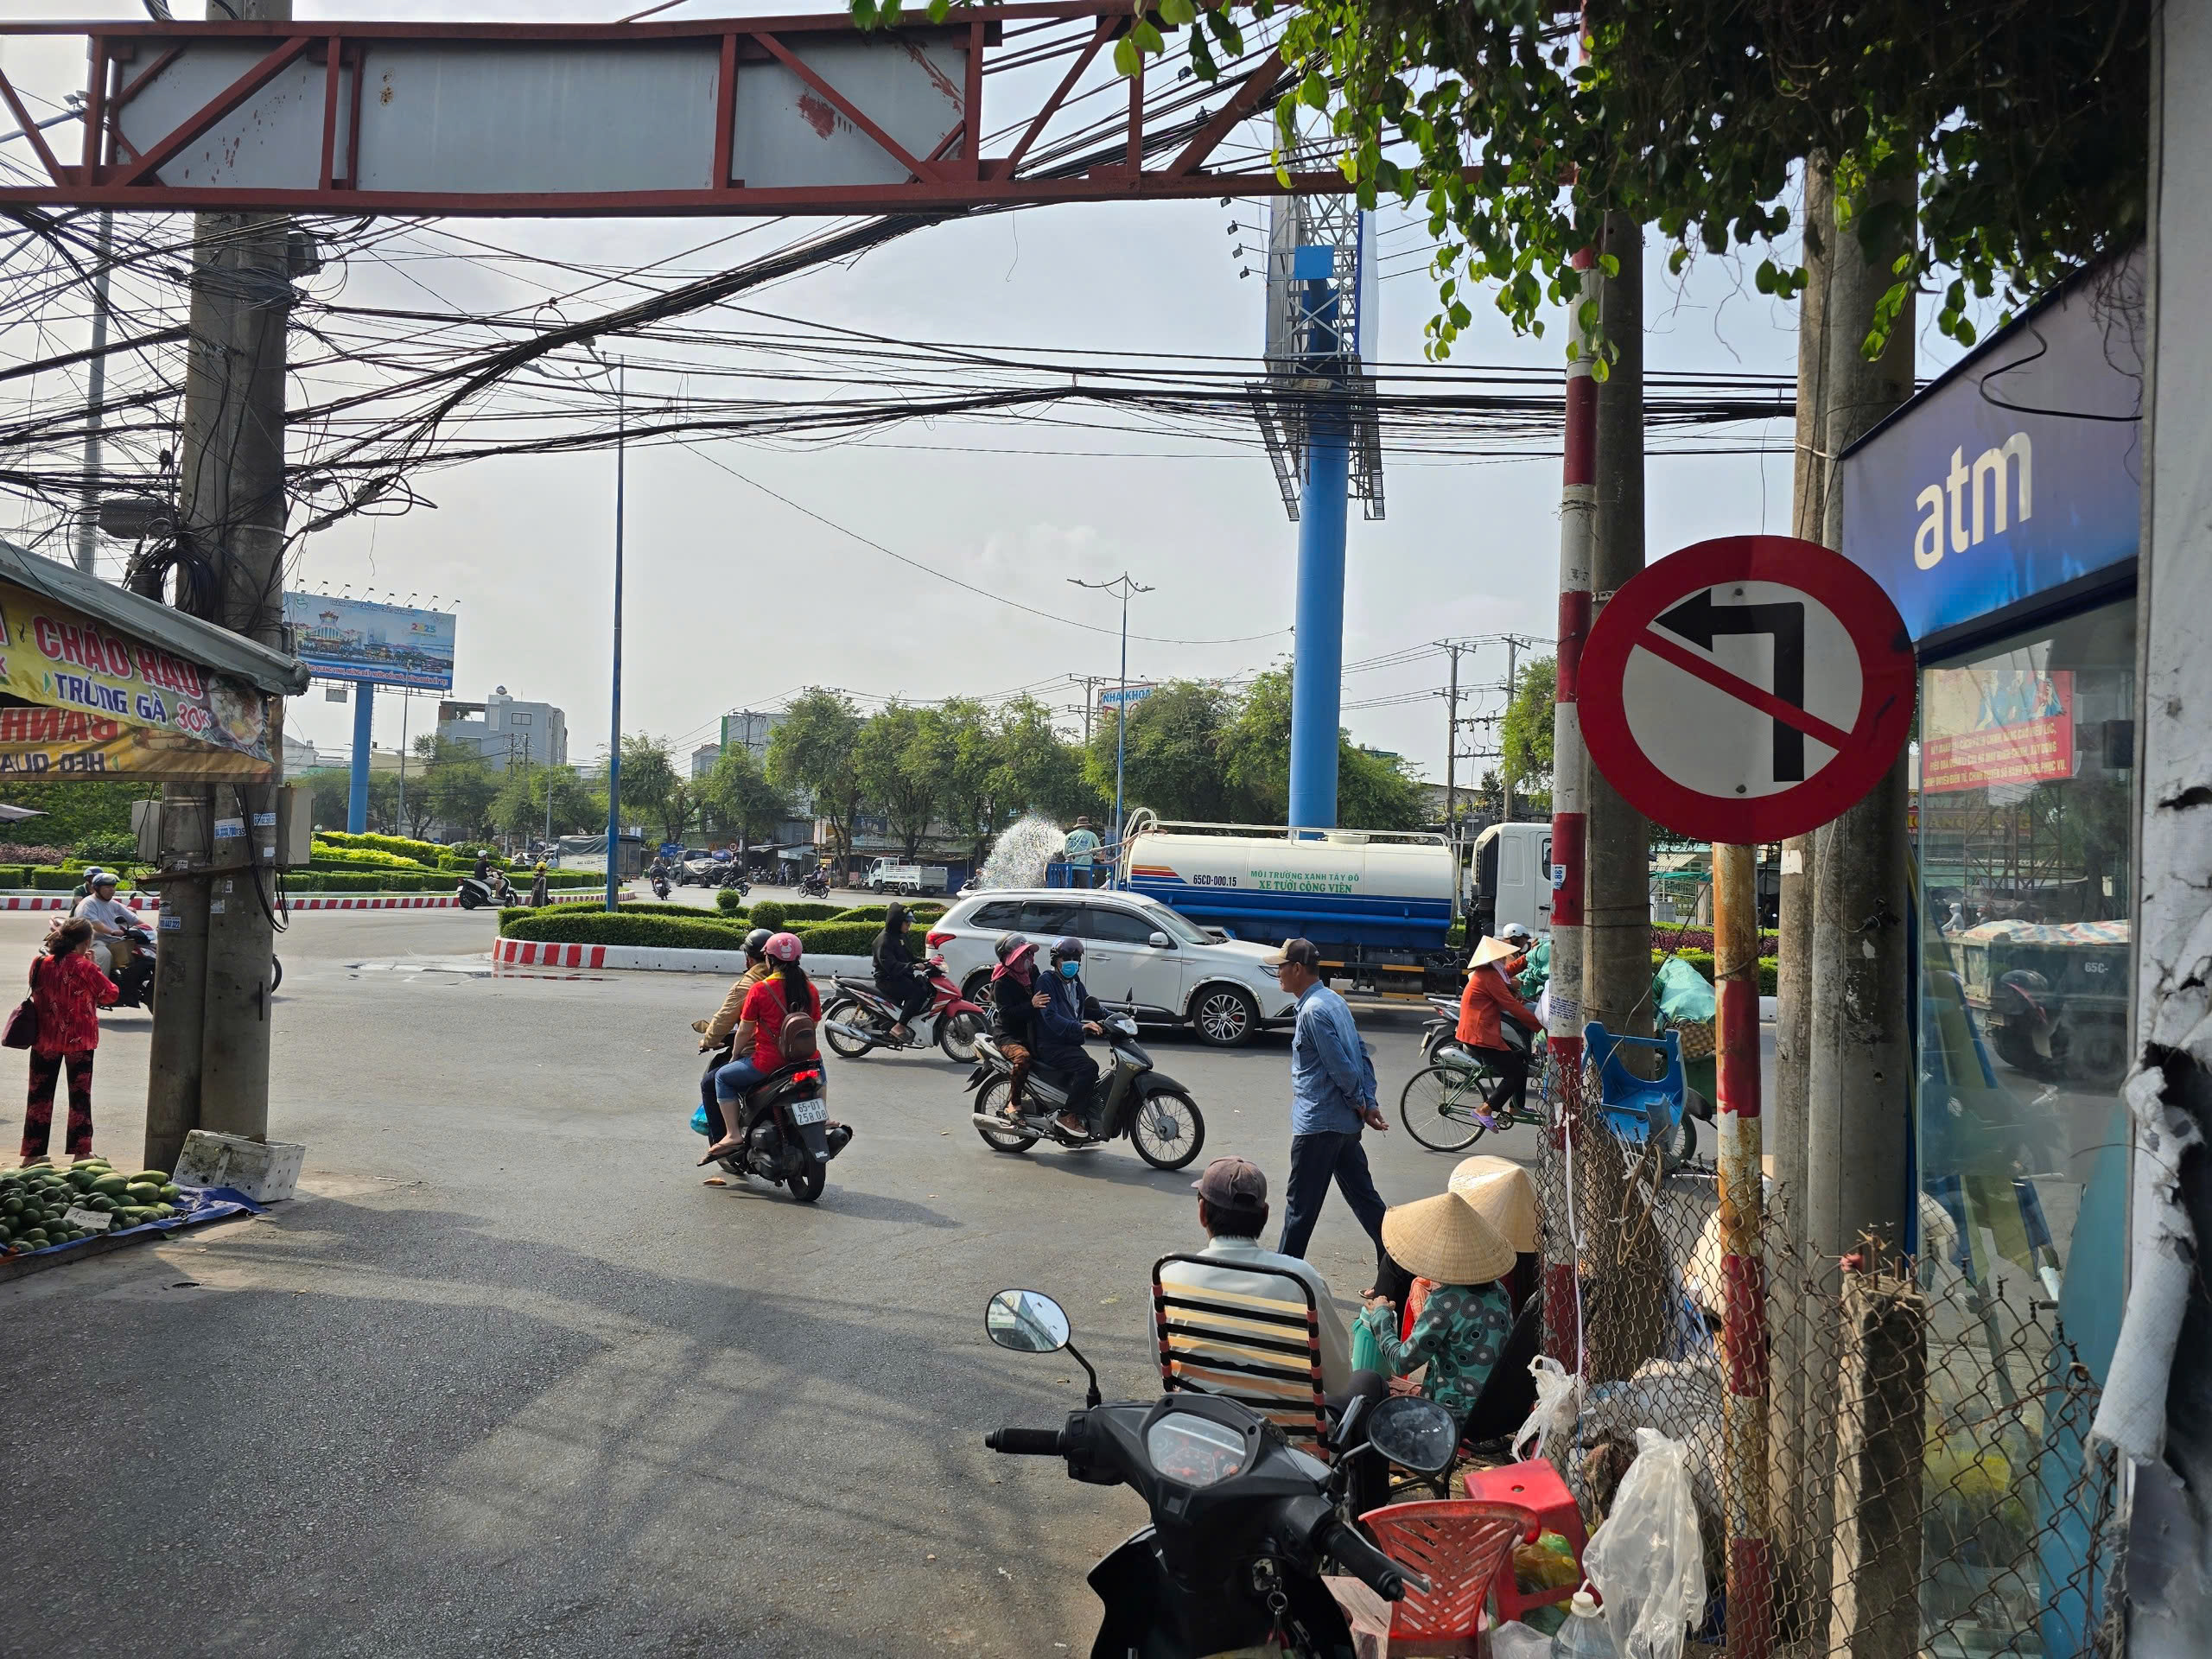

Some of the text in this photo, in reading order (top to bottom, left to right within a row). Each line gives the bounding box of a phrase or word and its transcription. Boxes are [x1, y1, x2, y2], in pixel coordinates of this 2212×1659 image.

[1914, 431, 2032, 570] atm
[1103, 689, 1151, 703] NHA KHOA
[136, 690, 168, 726] GÀ
[1193, 874, 1237, 887] 65CD-000.15
[1269, 869, 1303, 880] TRƯỜNG
[1304, 873, 1326, 881] XANH
[1329, 872, 1345, 881] TÂY
[1258, 880, 1272, 890] XE
[1299, 881, 1325, 893] CÔNG
[1328, 882, 1352, 893] VIÊN
[2085, 962, 2109, 973] 65C-
[798, 1109, 827, 1124] 258.08
